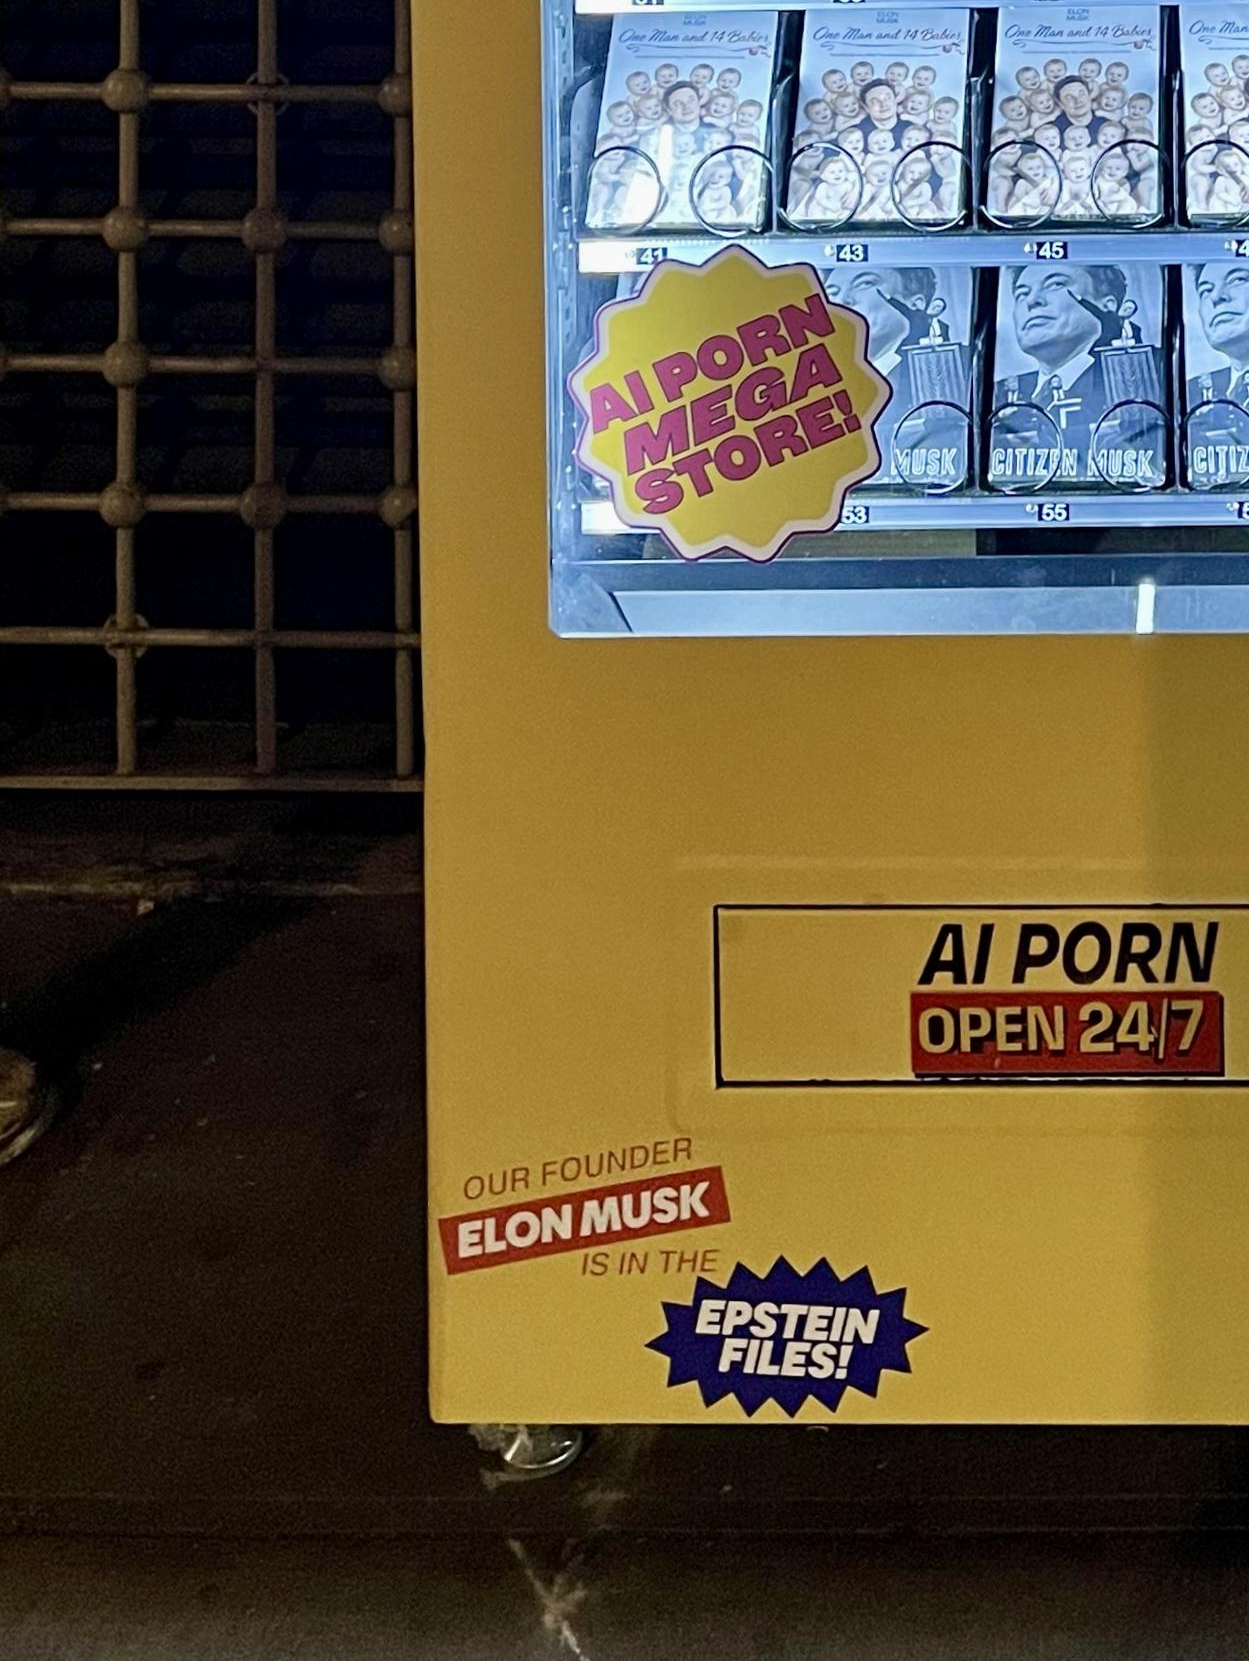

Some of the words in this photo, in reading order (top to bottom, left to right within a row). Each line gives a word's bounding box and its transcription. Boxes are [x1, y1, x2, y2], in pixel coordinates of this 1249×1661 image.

[619, 28, 645, 43] One
[648, 28, 679, 42] Man
[682, 30, 707, 42] and
[711, 30, 724, 42] 14
[725, 29, 768, 43] Babies
[813, 26, 840, 40] One
[842, 26, 873, 40] Man
[875, 28, 899, 40] and
[903, 28, 918, 40] 14
[919, 27, 961, 41] Babies
[1004, 24, 1031, 38] One
[1034, 24, 1063, 38] Man
[1067, 26, 1093, 38] and
[1095, 25, 1108, 37] 14
[1110, 24, 1152, 38] Babies
[1189, 20, 1216, 35] One
[1219, 20, 1249, 33] Man
[640, 248, 663, 263] 41
[838, 245, 864, 261] 43
[1039, 242, 1064, 259] 45
[589, 371, 655, 434] AI
[653, 293, 836, 403] PORN
[624, 343, 842, 474] MEGA
[634, 390, 863, 515] STORE!
[891, 448, 957, 475] MUSK
[991, 448, 1078, 476] CITIZEN
[1088, 449, 1153, 477] MUSK
[843, 506, 868, 524] 53
[1042, 504, 1067, 521] 55
[916, 922, 995, 986] AI
[1012, 920, 1219, 986] PORN
[918, 1004, 1066, 1055] OPEN
[1077, 998, 1205, 1061] 24/7
[463, 1165, 530, 1200] OUR
[541, 1137, 694, 1184] FOUNDER
[456, 1204, 573, 1259] ELON
[579, 1180, 711, 1237] MUSK
[581, 1251, 609, 1276] IS
[618, 1251, 648, 1276] IN
[659, 1248, 721, 1274] THE
[694, 1298, 881, 1345] EPSTEIN
[717, 1337, 854, 1380] FILES!
